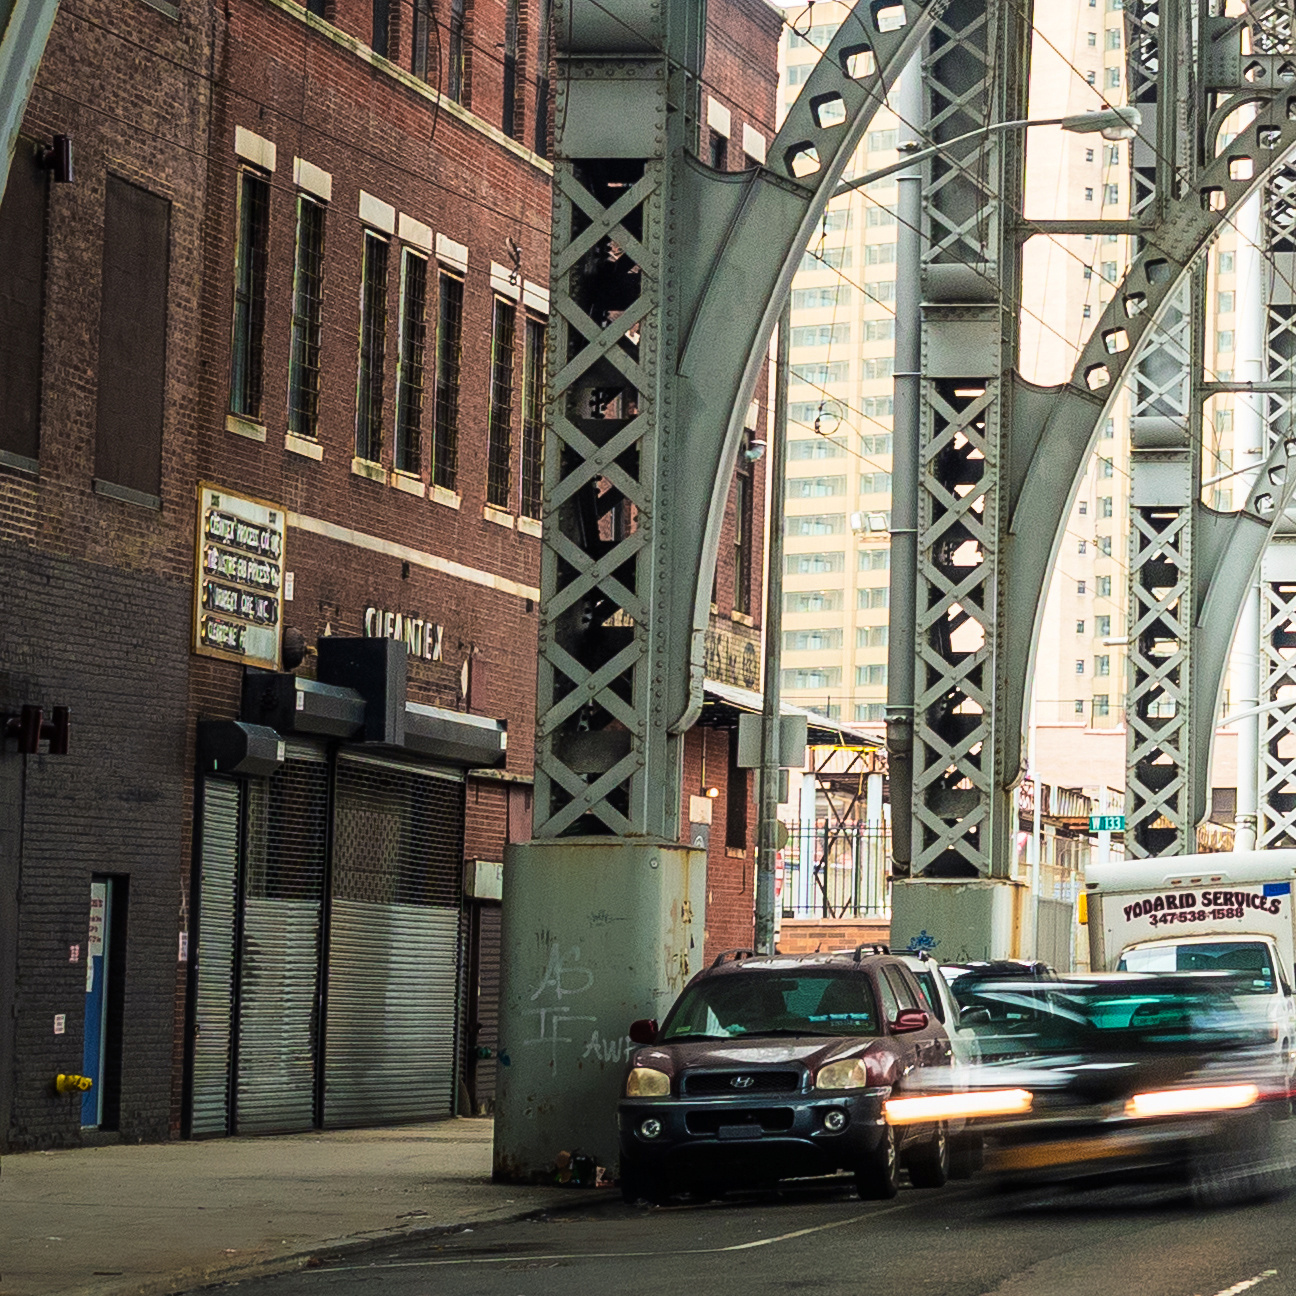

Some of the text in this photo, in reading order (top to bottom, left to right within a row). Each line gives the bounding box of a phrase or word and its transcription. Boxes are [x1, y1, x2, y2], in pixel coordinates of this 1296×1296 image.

[1091, 816, 1121, 830] W 133
[1201, 891, 1282, 915] SERVICES
